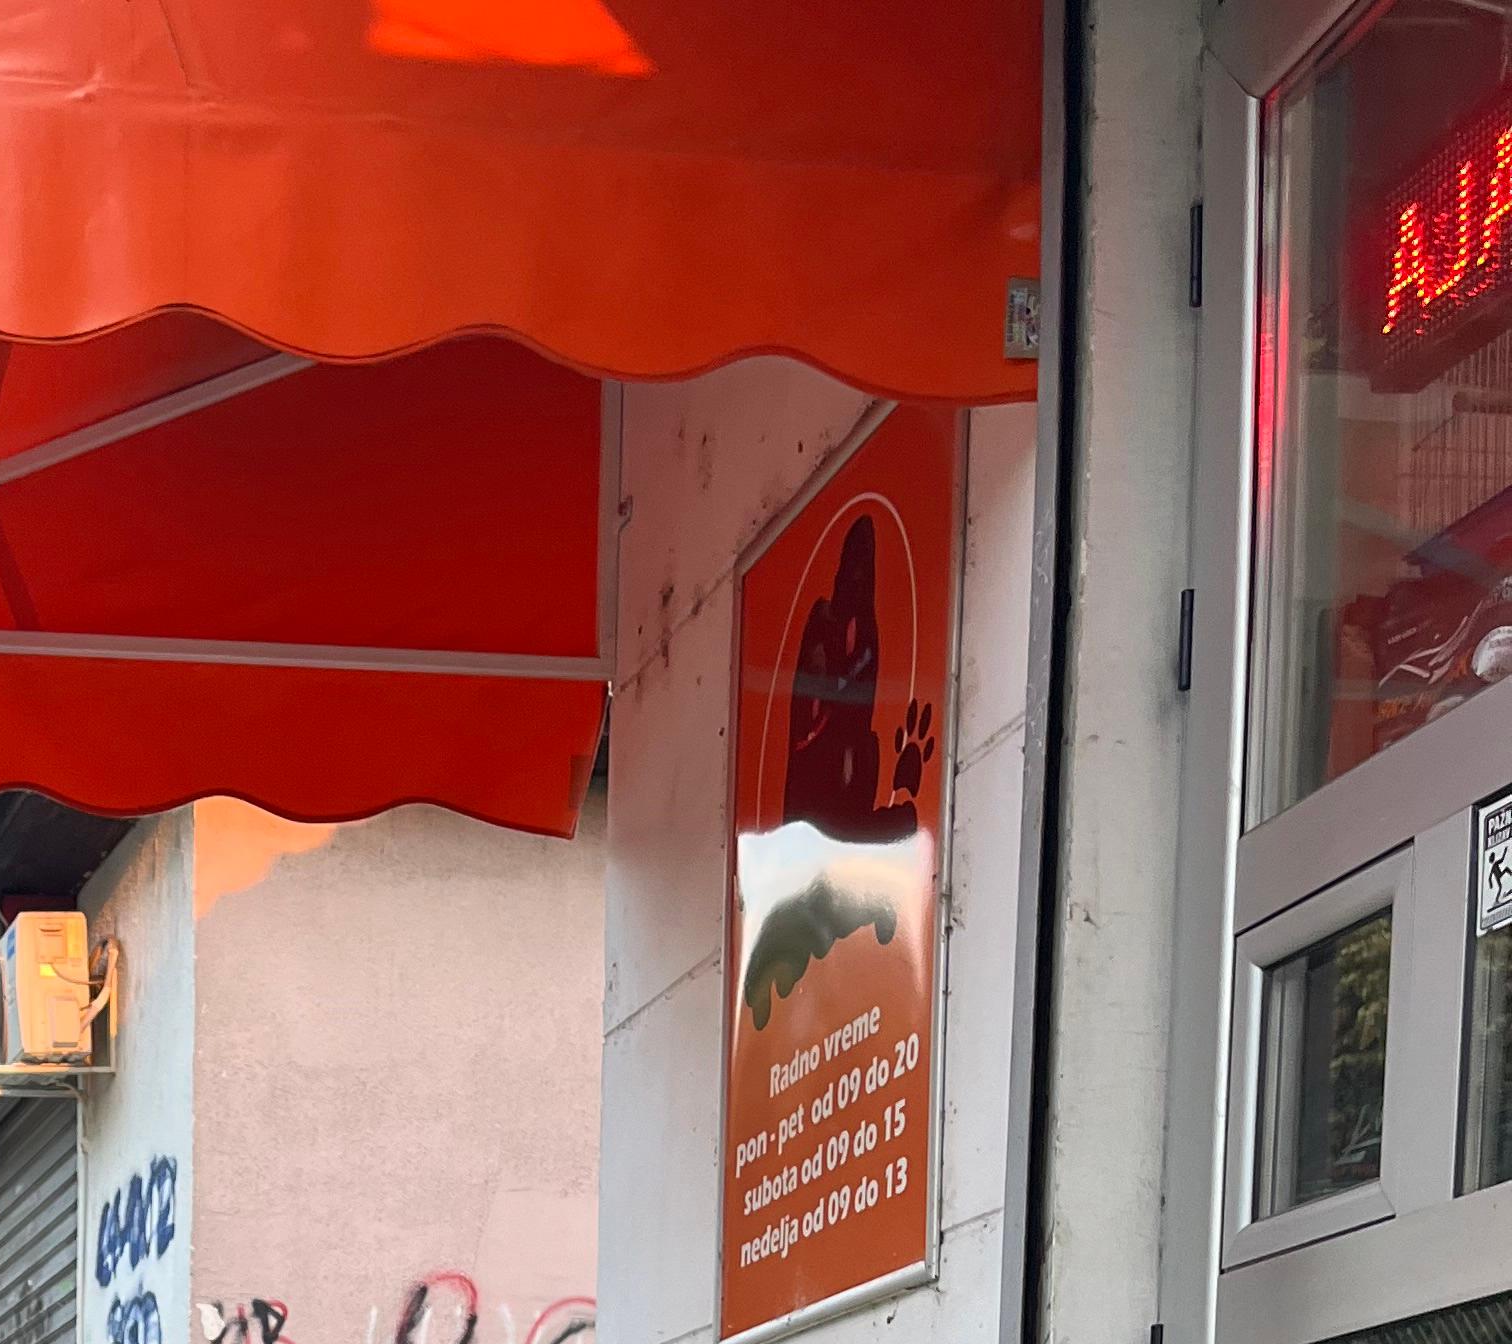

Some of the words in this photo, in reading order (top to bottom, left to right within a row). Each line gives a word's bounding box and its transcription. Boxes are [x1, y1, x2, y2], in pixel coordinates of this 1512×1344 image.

[769, 1044, 820, 1099] Radno
[823, 1005, 881, 1062] vreme
[811, 1082, 834, 1124] od
[838, 1067, 861, 1110] 09
[865, 1055, 889, 1094] do
[893, 1032, 919, 1079] 20
[743, 1165, 797, 1216] subota
[801, 1144, 823, 1185] od
[826, 1130, 849, 1171] 09
[853, 1120, 878, 1157] do
[883, 1098, 906, 1142] 15
[740, 1214, 799, 1268] nedelja
[802, 1197, 824, 1238] od
[827, 1184, 851, 1226] 09
[854, 1175, 879, 1213] do
[885, 1156, 908, 1199] 13
